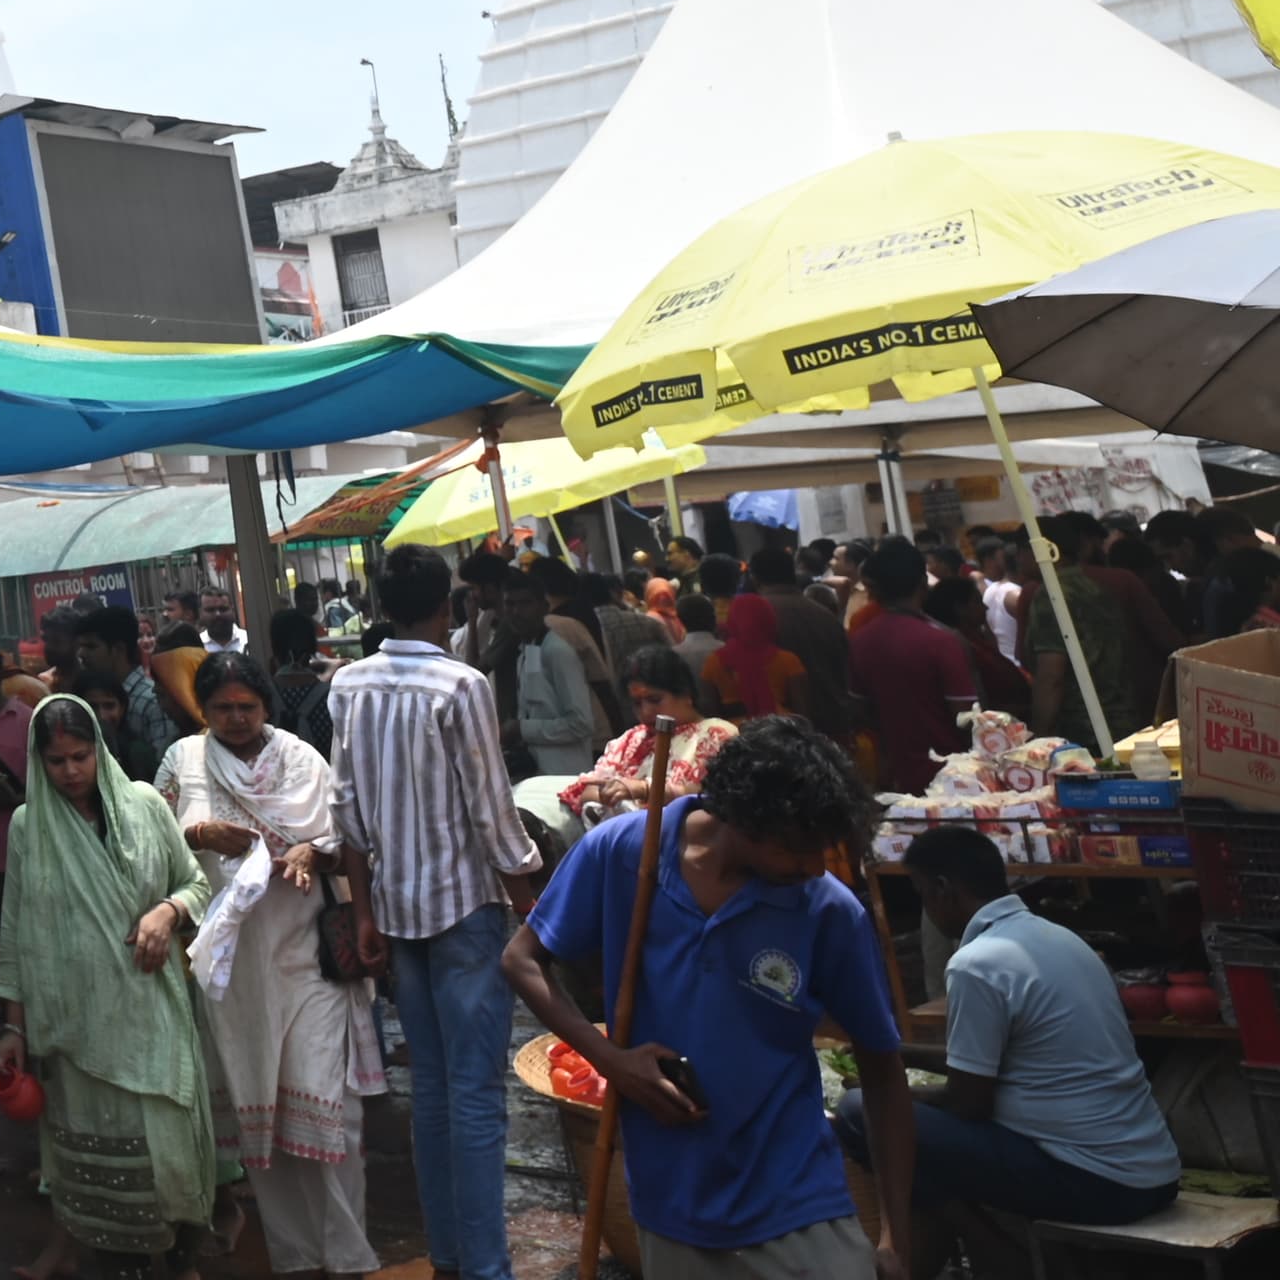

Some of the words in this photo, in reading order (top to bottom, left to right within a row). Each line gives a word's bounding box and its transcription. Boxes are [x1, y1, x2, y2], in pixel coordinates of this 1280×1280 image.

[793, 338, 873, 370] INDIA'S
[877, 325, 924, 350] NO.1
[930, 321, 983, 342] CEM
[657, 382, 698, 401] CEMENT
[34, 577, 88, 598] CONTROL
[90, 573, 126, 592] ROOM
